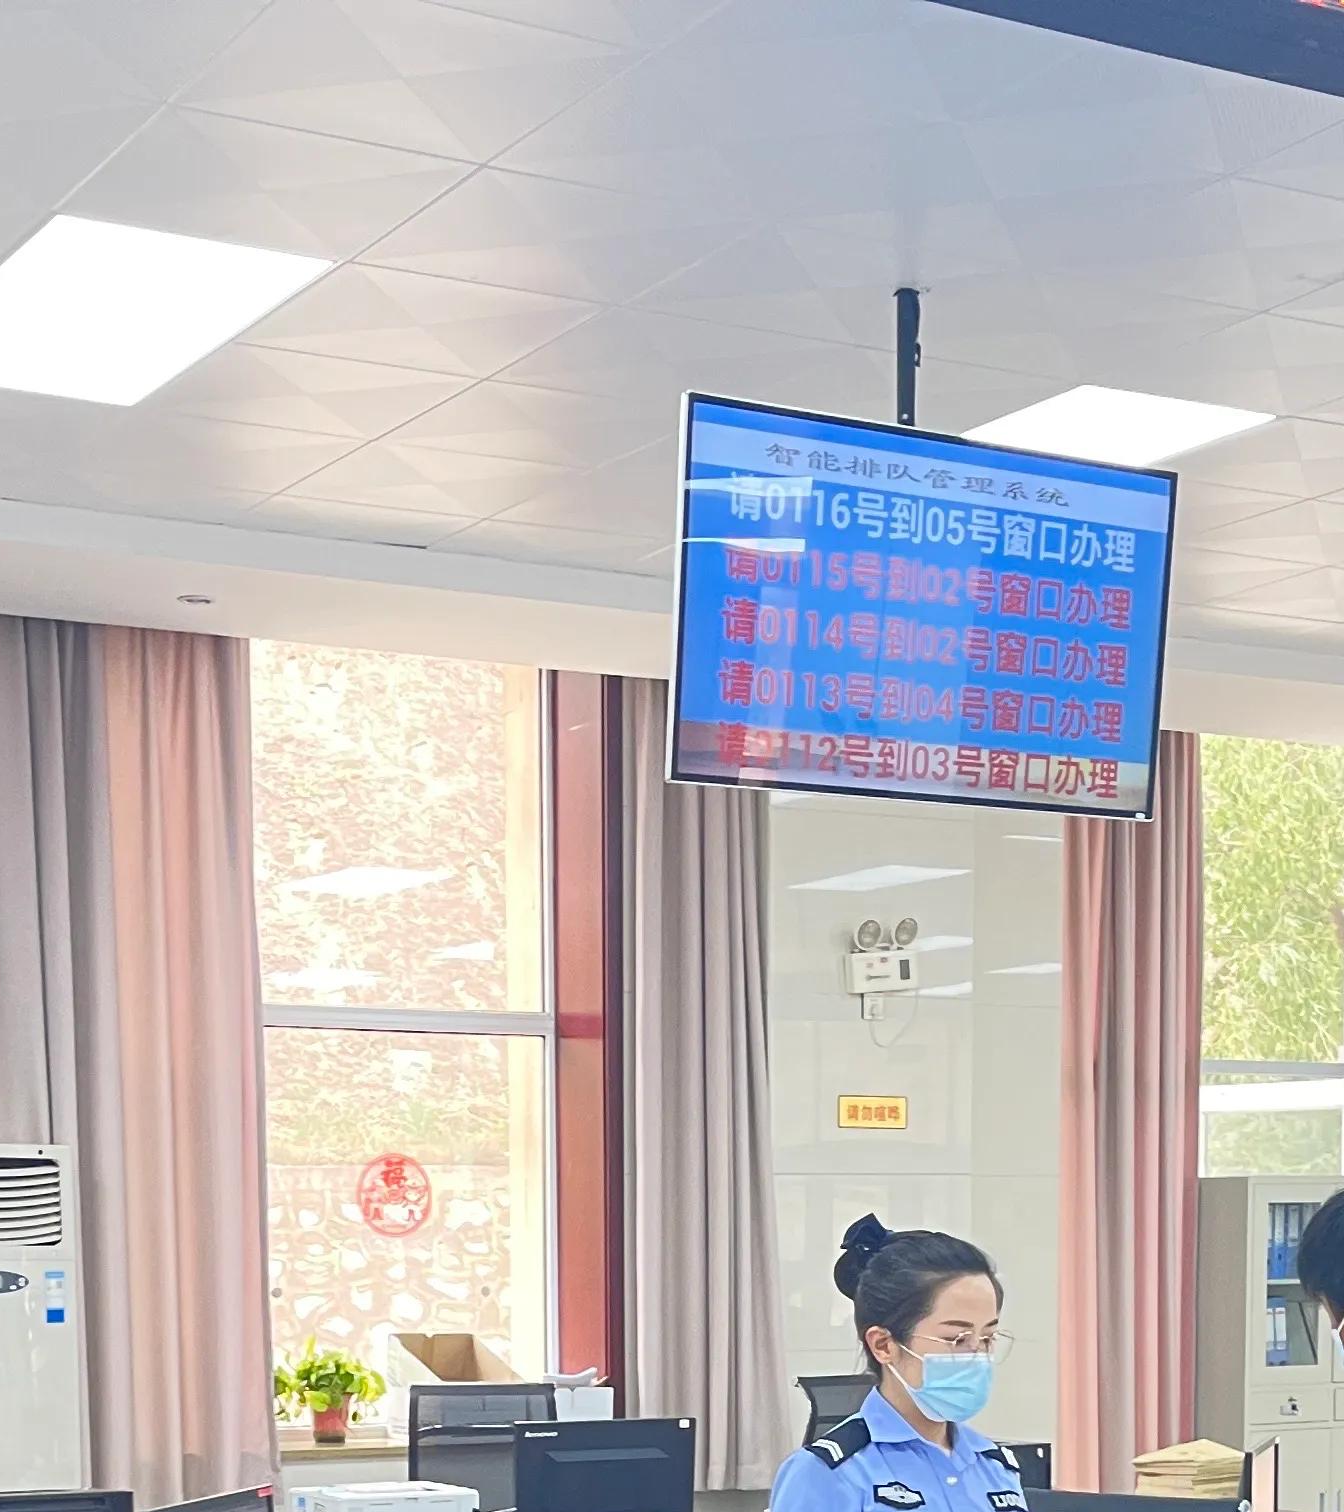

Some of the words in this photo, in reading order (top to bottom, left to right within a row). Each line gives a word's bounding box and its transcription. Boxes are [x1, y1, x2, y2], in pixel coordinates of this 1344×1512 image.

[764, 441, 1071, 509] 智能排队管理系统
[729, 472, 1136, 574] 请0116号到05号窗口办理
[724, 542, 1133, 632] 请0115号到02号窗口办理
[720, 598, 1128, 687] 请0114号到02号窗口办理
[717, 657, 1125, 744] 请0113号到04号窗口办理
[713, 722, 1119, 800] 请0112号到03号窗口办理
